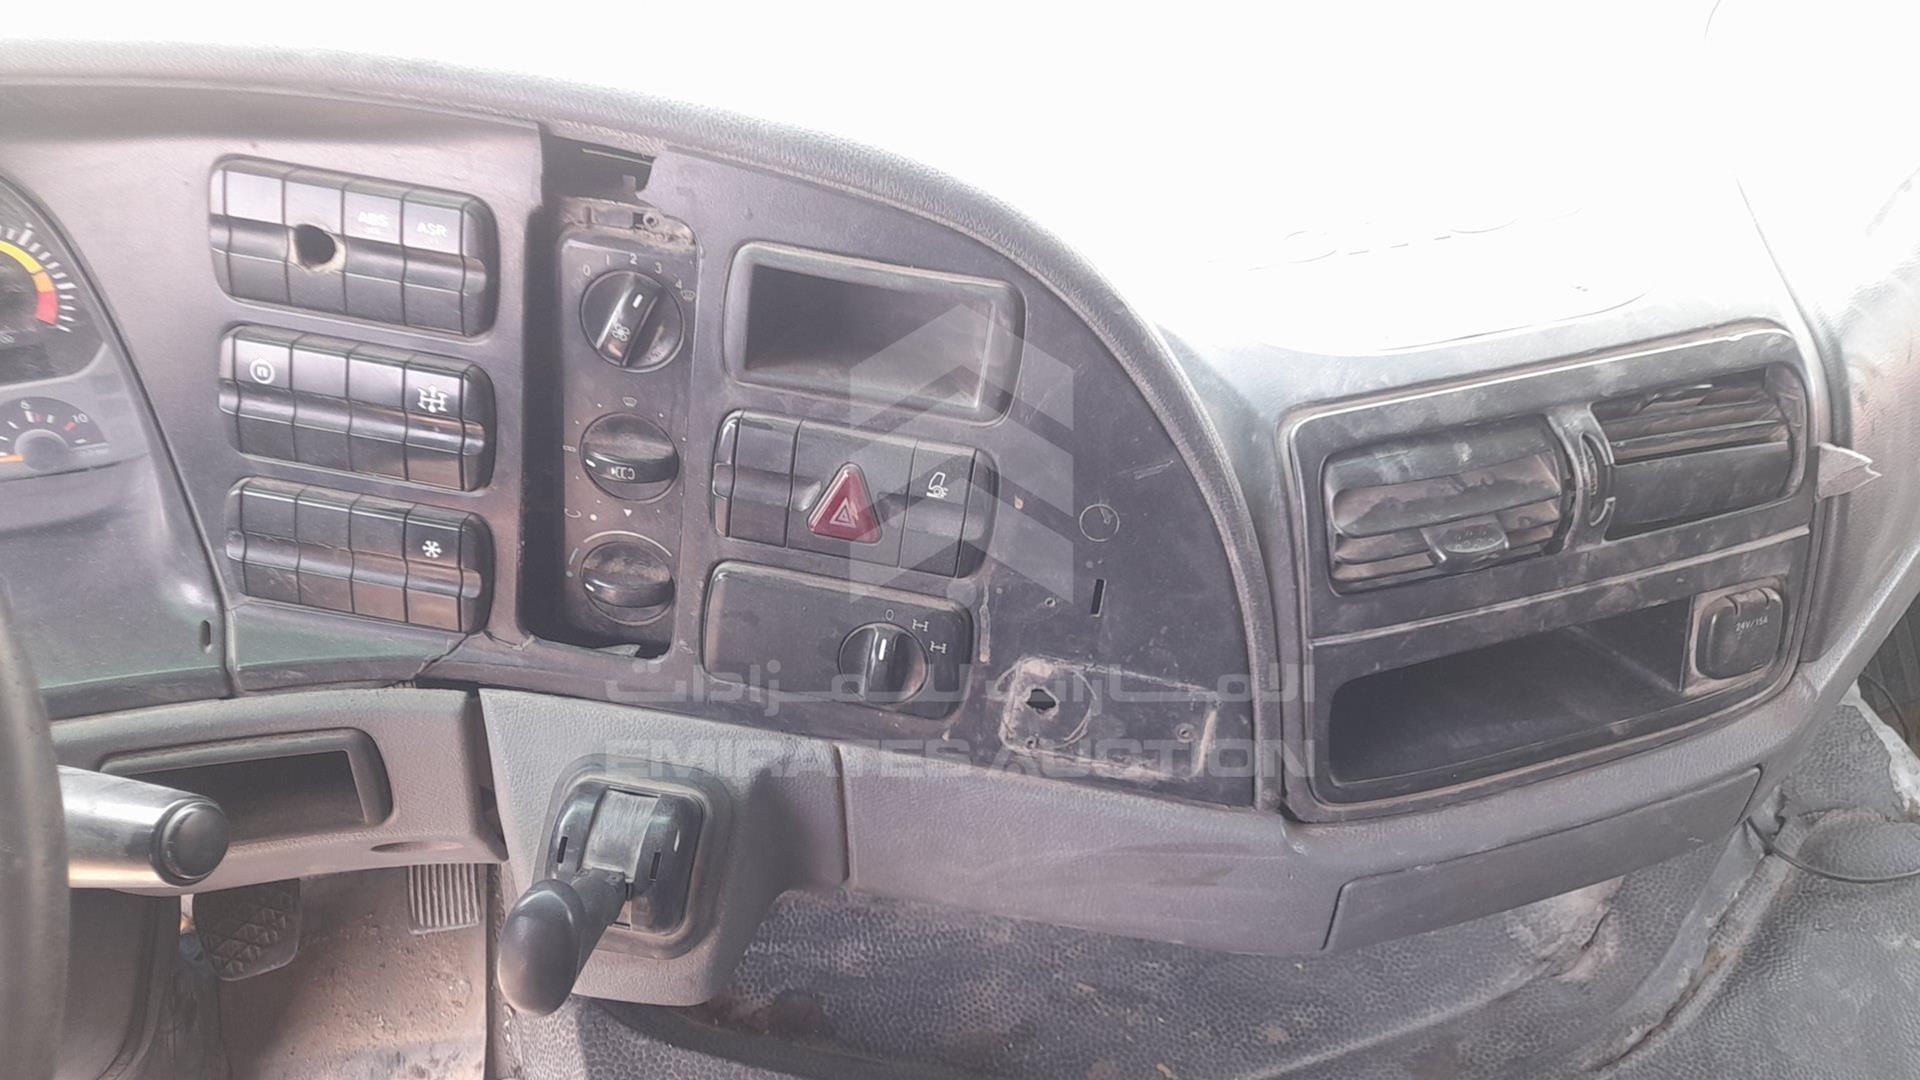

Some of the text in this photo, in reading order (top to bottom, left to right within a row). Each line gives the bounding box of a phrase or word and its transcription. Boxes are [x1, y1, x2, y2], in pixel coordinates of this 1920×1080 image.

[416, 222, 448, 237] ASR
[582, 264, 591, 277] 0
[629, 253, 638, 265] 2
[655, 262, 663, 274] 3
[675, 279, 682, 289] 4
[72, 412, 89, 423] 10
